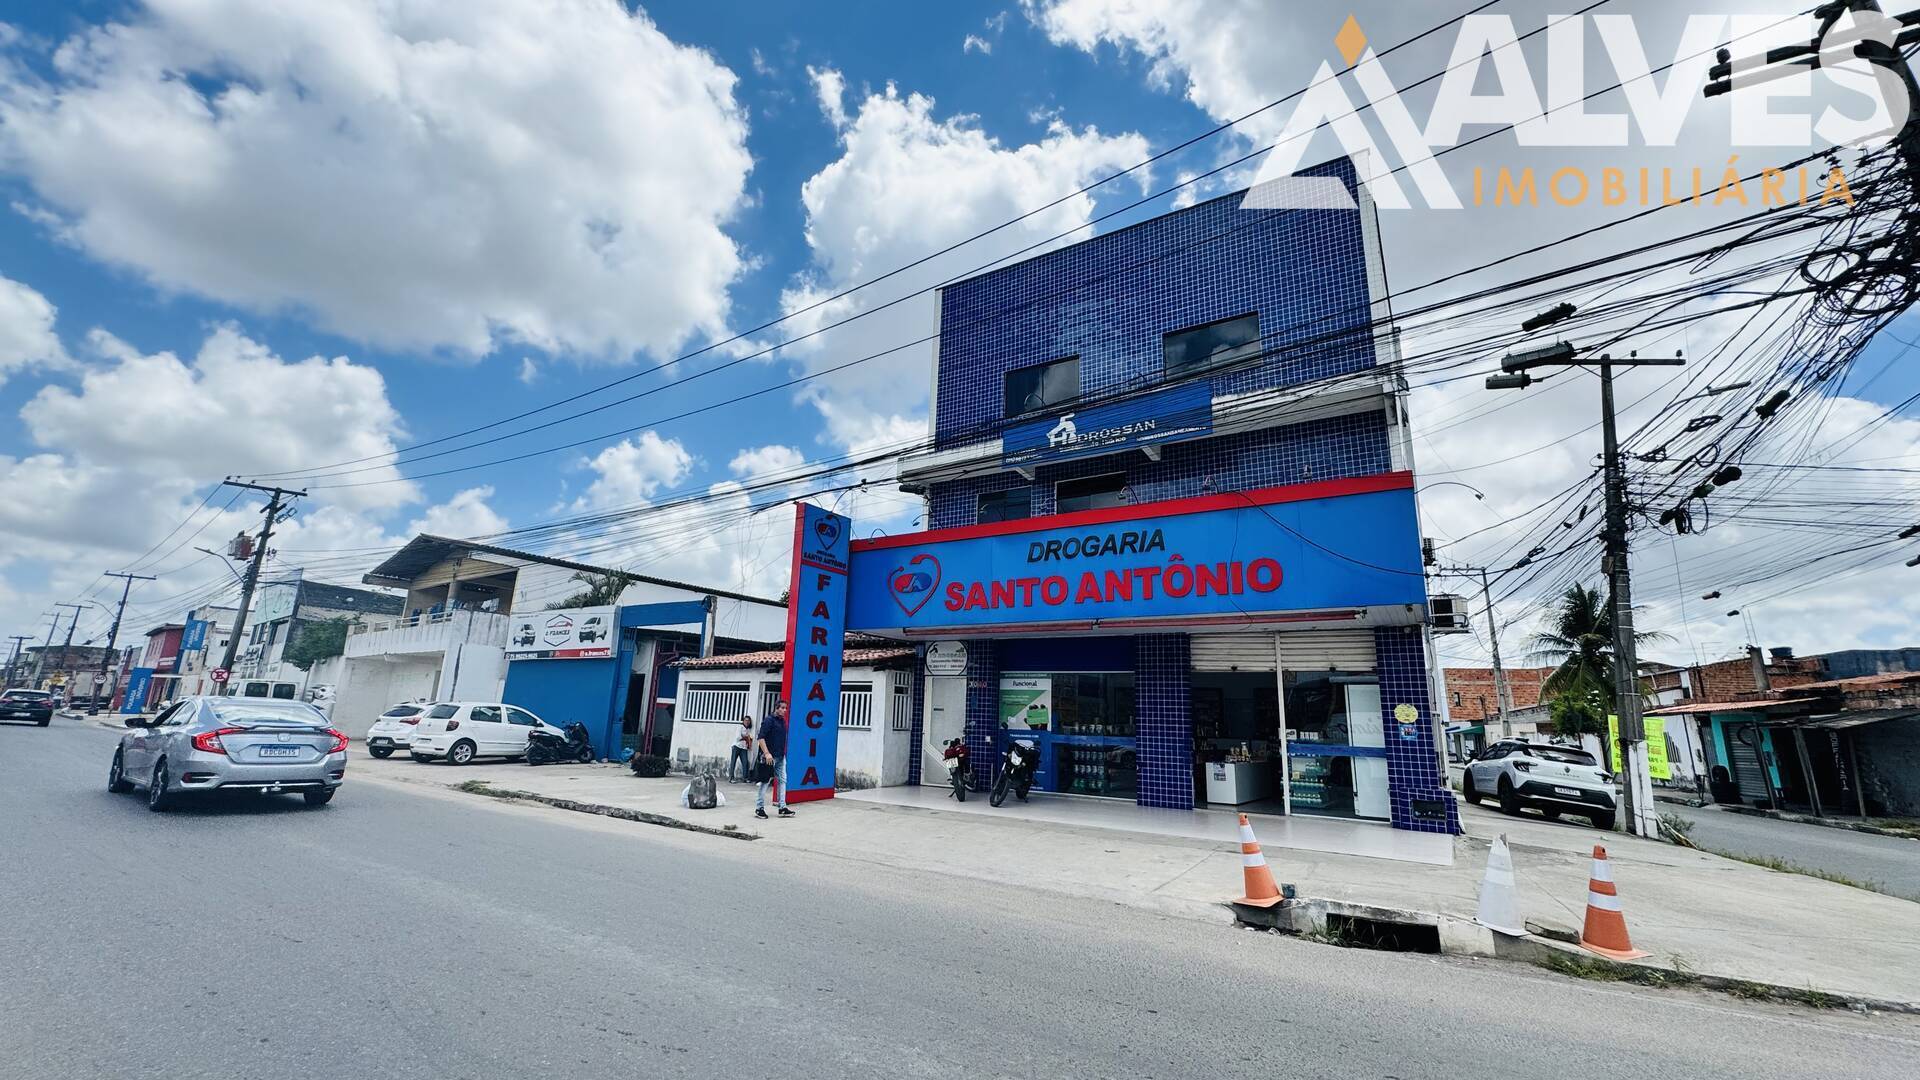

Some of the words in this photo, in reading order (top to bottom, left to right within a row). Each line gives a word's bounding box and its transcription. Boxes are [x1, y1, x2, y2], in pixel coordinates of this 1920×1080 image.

[1026, 528, 1166, 563] DROGARIA
[944, 575, 1070, 612] SANTO
[1073, 554, 1284, 604] ANTÔNIO
[800, 574, 832, 785] FARMÁCIA
